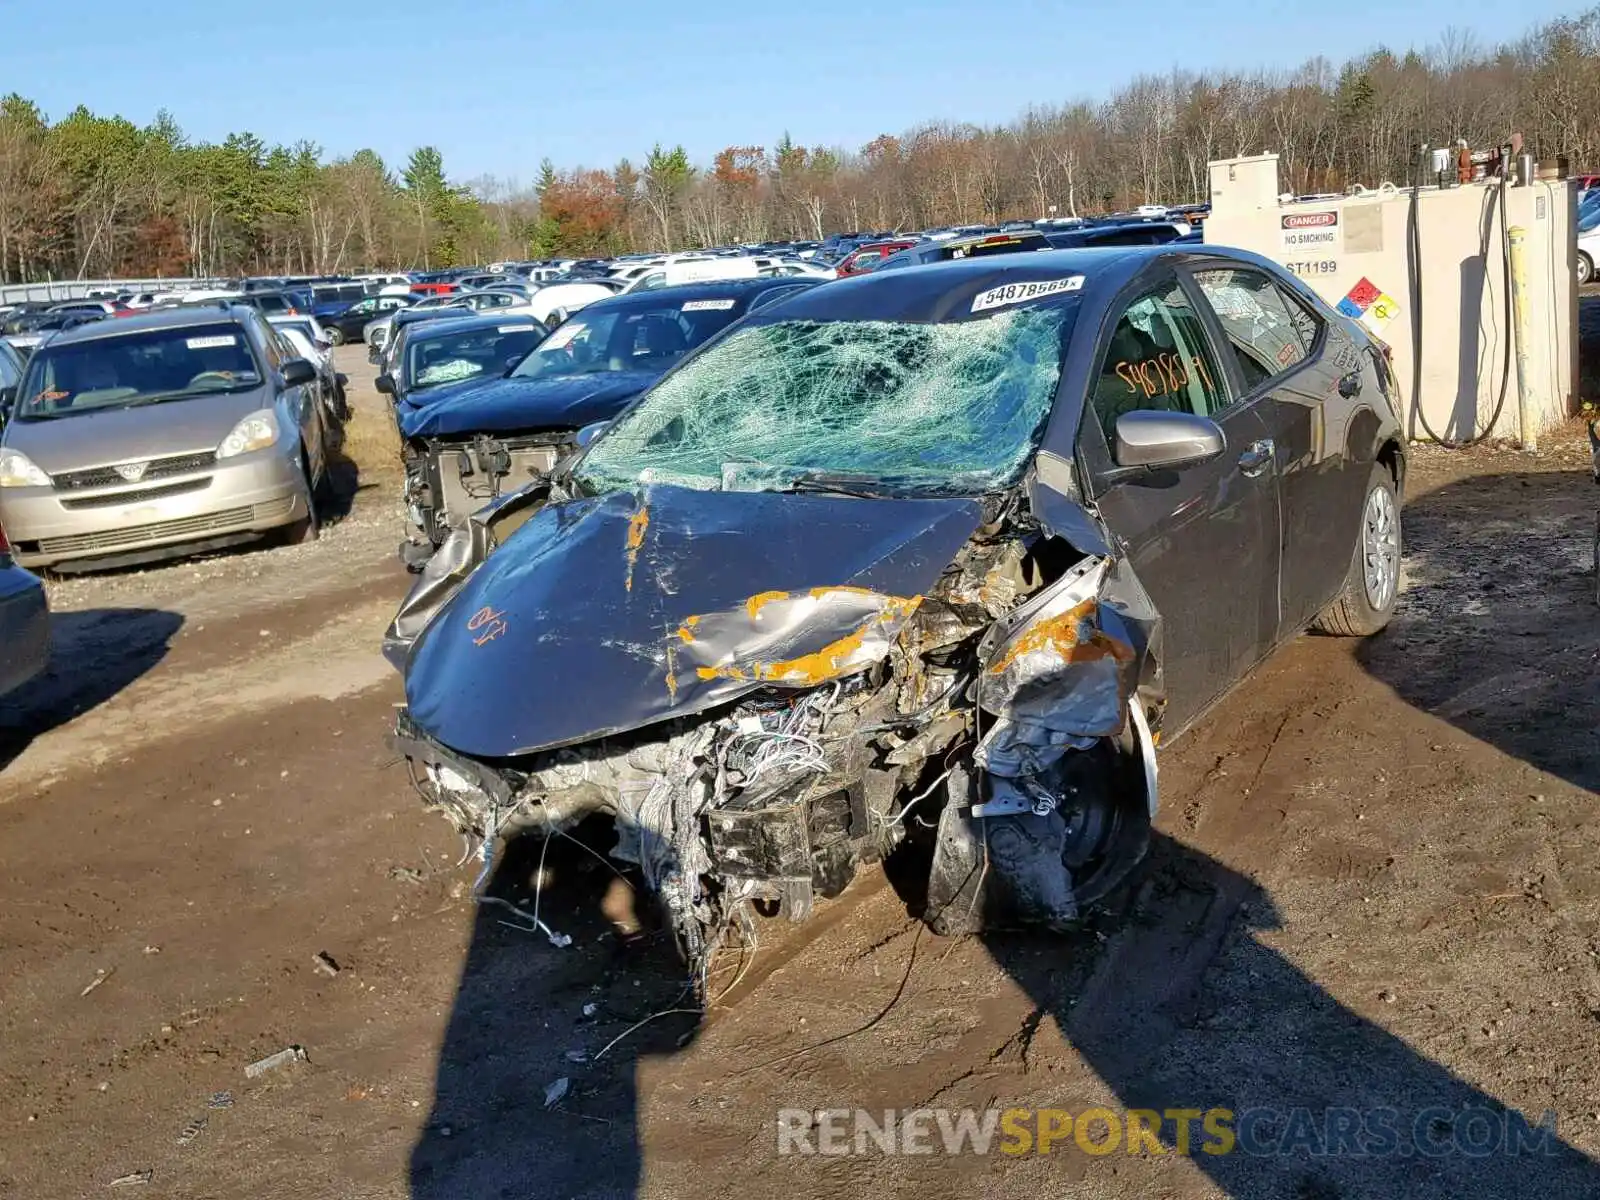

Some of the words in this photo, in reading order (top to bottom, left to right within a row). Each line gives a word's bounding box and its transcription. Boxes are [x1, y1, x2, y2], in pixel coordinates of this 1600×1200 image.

[1289, 215, 1329, 226] DANGER
[1285, 234, 1297, 244] NO
[1299, 232, 1334, 244] SMOKING
[1286, 260, 1337, 274] ST1199
[986, 279, 1070, 304] 54878569
